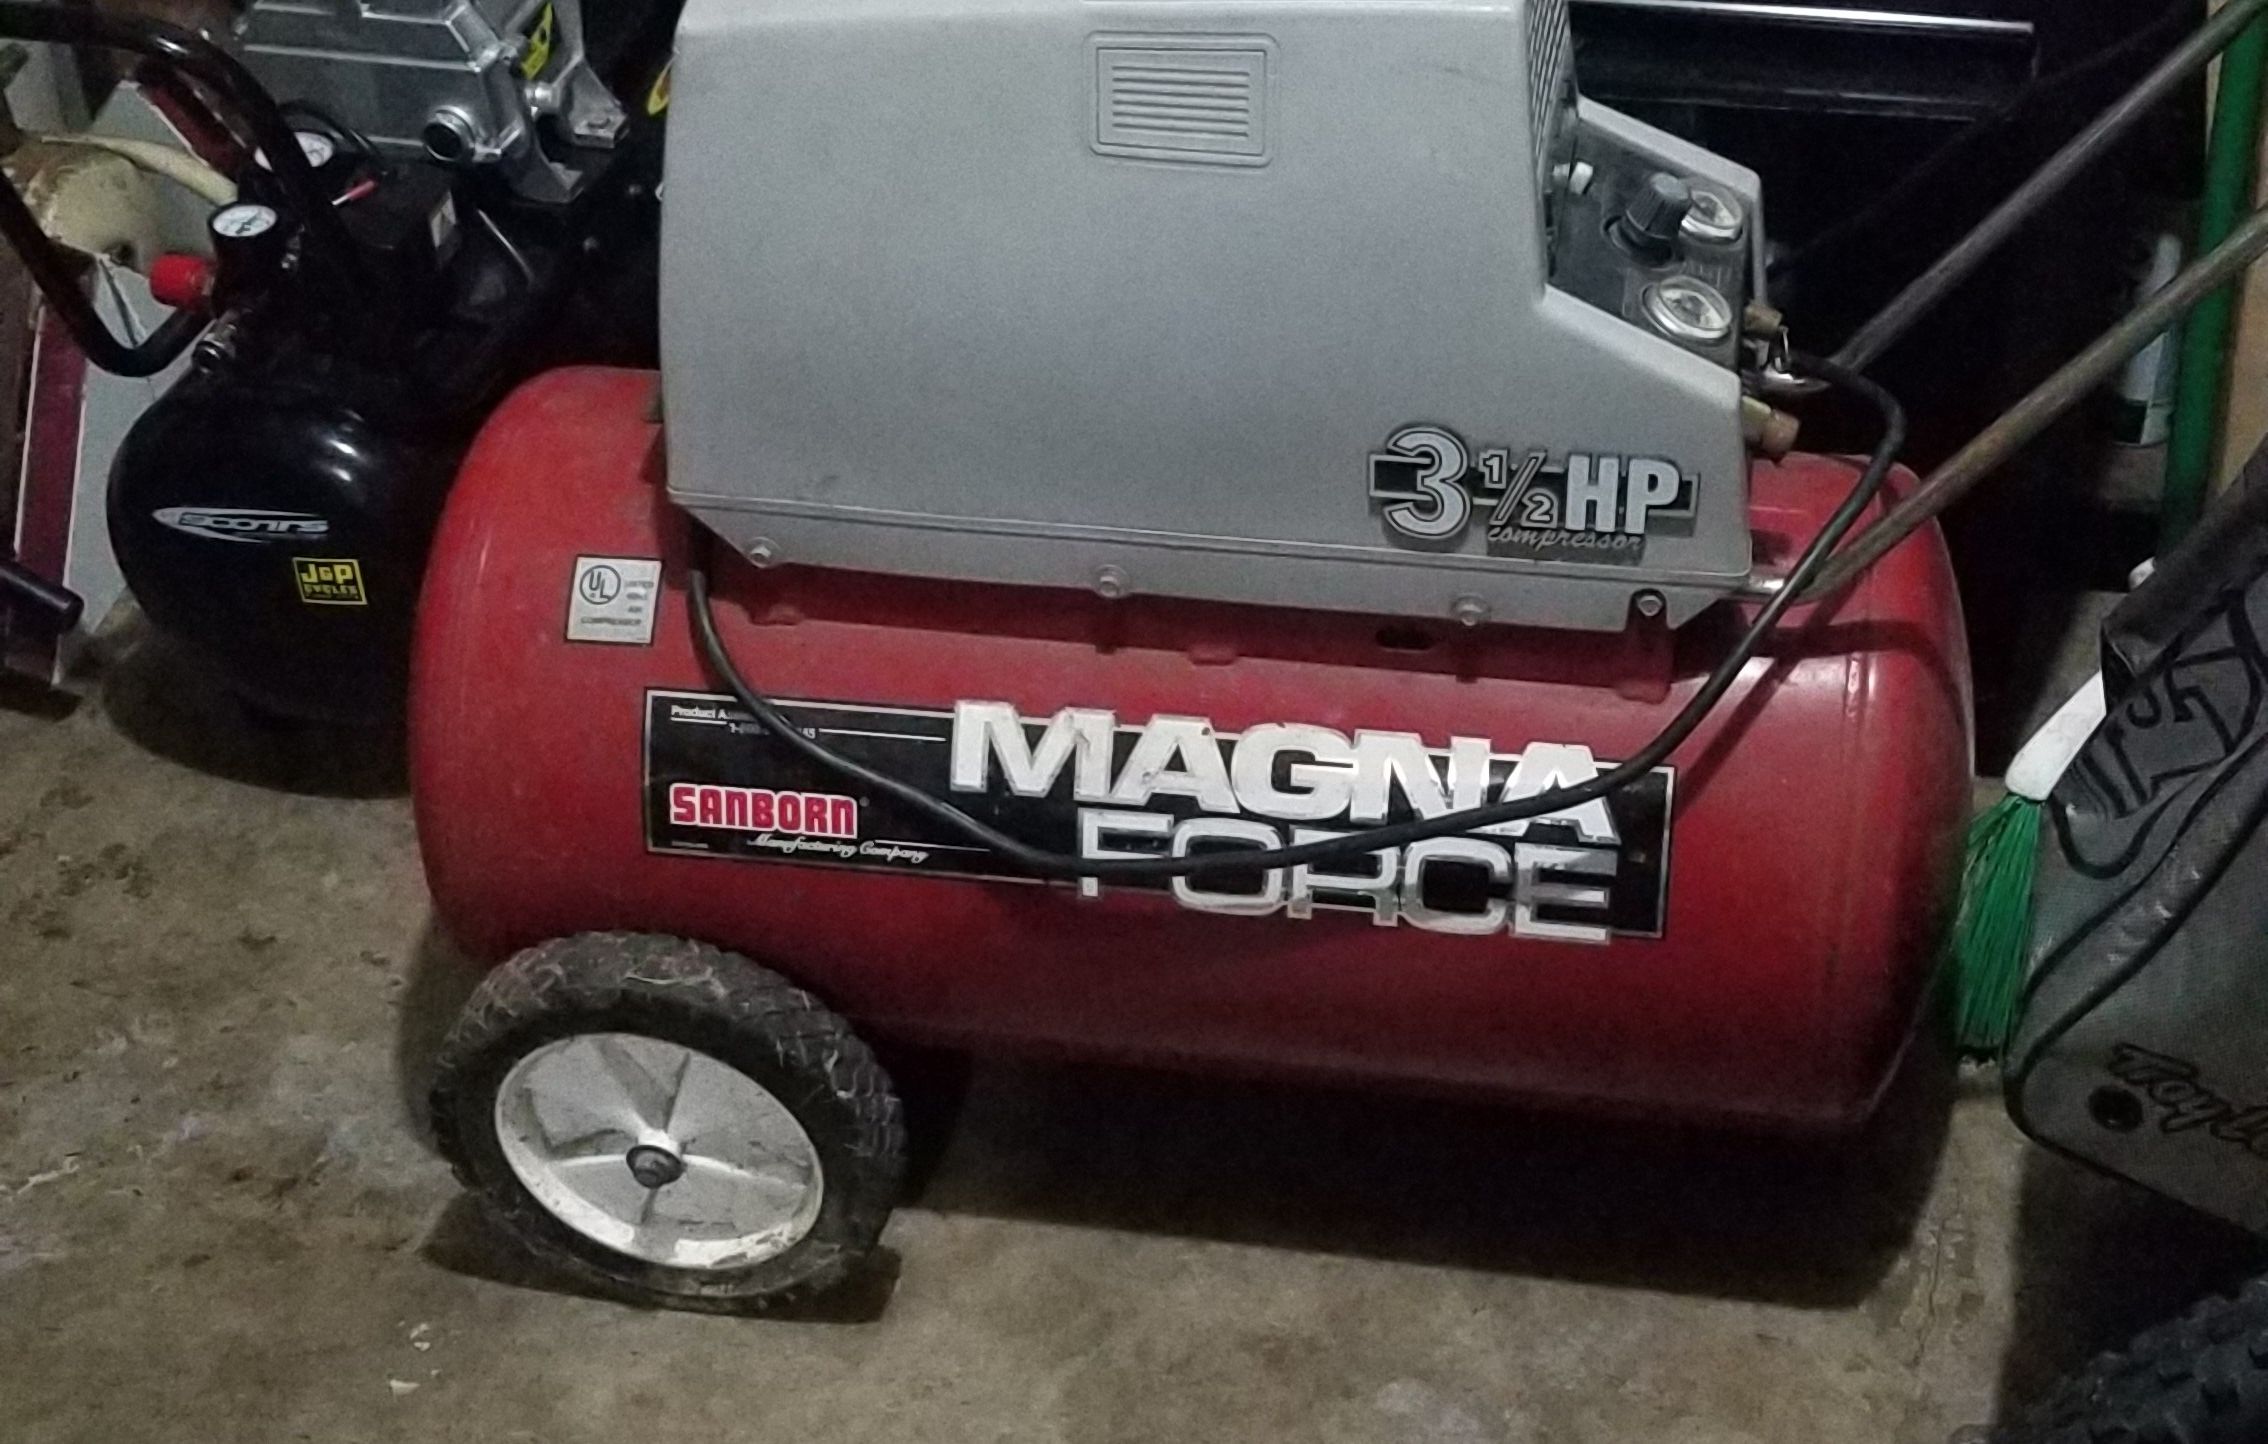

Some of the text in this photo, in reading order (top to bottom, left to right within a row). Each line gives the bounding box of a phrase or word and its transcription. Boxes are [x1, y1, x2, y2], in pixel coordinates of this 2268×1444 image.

[1384, 427, 1471, 540] 3
[1565, 454, 1680, 535] HP
[1487, 525, 1642, 551] compressor
[671, 705, 716, 719] Product
[951, 700, 1622, 845] MAGNA
[669, 783, 858, 839] SANBORN
[860, 840, 930, 863] Company
[1077, 807, 1617, 944] FORCE
